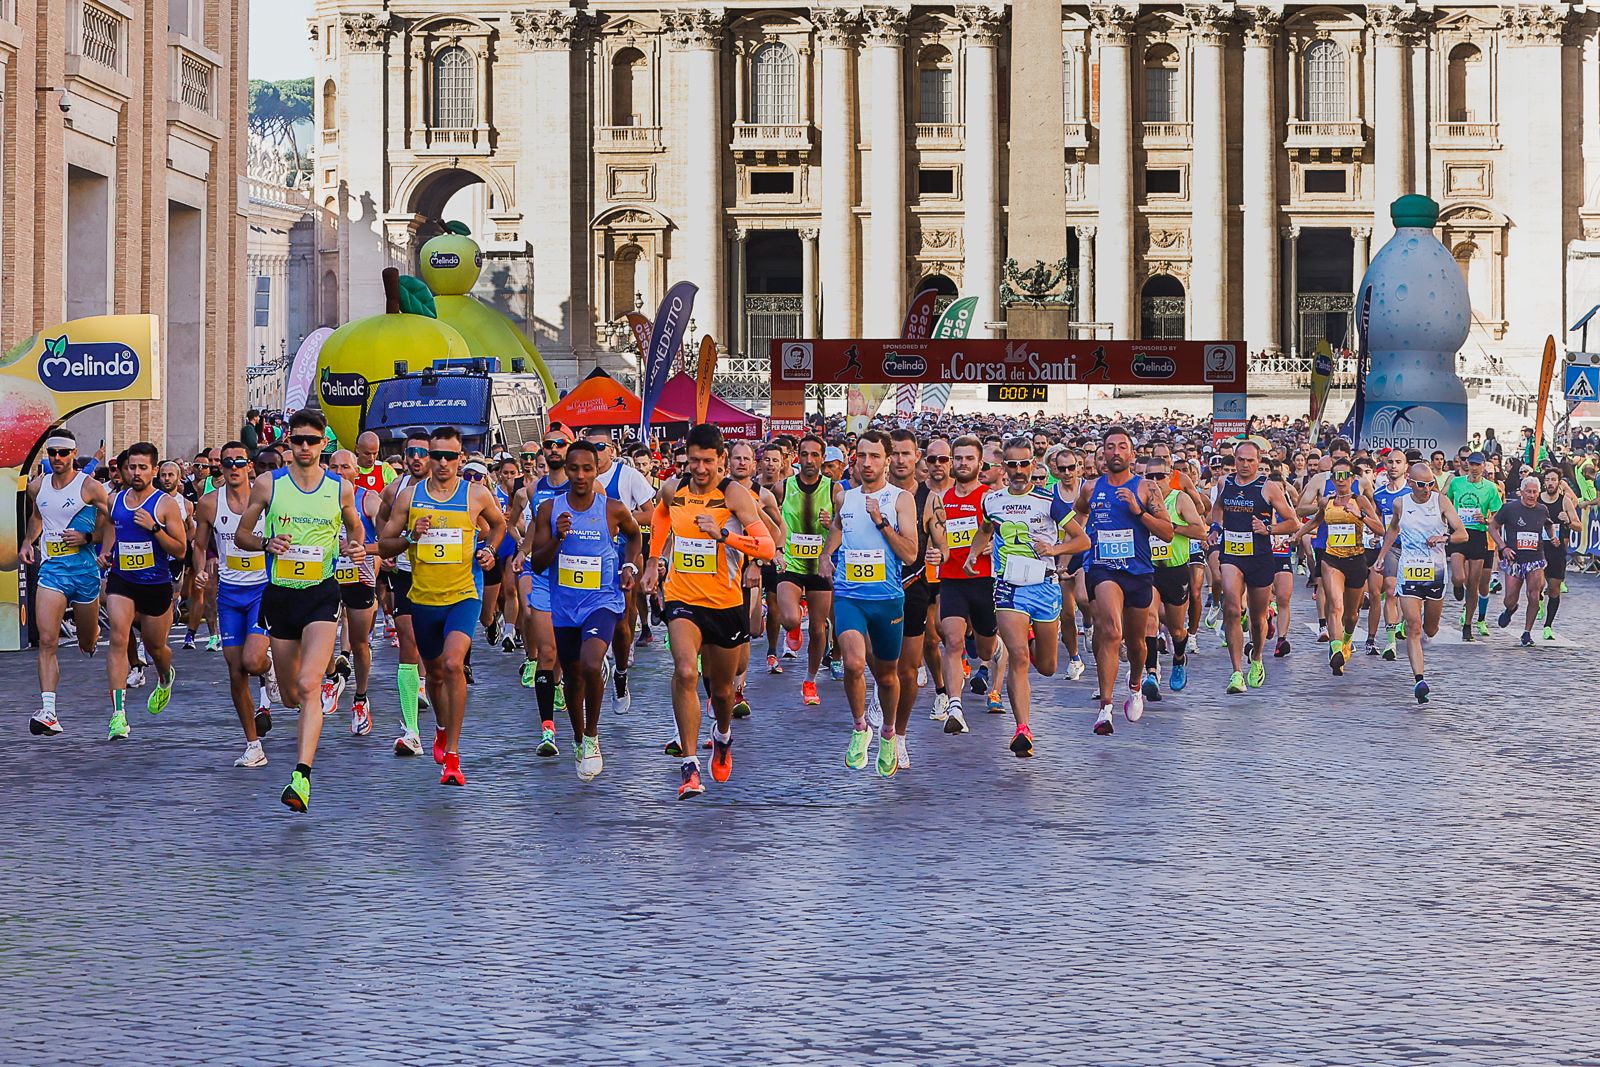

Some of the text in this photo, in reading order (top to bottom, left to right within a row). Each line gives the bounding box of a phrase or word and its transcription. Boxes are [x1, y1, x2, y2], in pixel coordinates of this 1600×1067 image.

[430, 255, 459, 265] Melinda
[43, 352, 134, 377] Melinda
[885, 360, 924, 371] Melinda
[941, 352, 1077, 381] la Corsa dei Santi
[1133, 361, 1173, 372] Melinda
[388, 399, 467, 409] POLIZIA
[1002, 504, 1032, 512] FONTANA
[1224, 498, 1254, 507] RUNNERS
[952, 530, 970, 544] 34
[1334, 533, 1348, 544] 77
[52, 541, 70, 554] 32
[794, 544, 818, 555] 108
[1102, 543, 1130, 556] 186
[1230, 541, 1245, 553] 23
[1517, 539, 1538, 548] 1875
[434, 544, 445, 558] 3
[1151, 545, 1168, 557] 09
[126, 554, 145, 567] 30
[241, 556, 251, 569] 5
[683, 553, 705, 568] 56
[294, 561, 305, 577] 2
[335, 568, 355, 580] 03
[853, 564, 874, 578] 38
[1406, 567, 1431, 578] 102
[573, 570, 584, 584] 6
